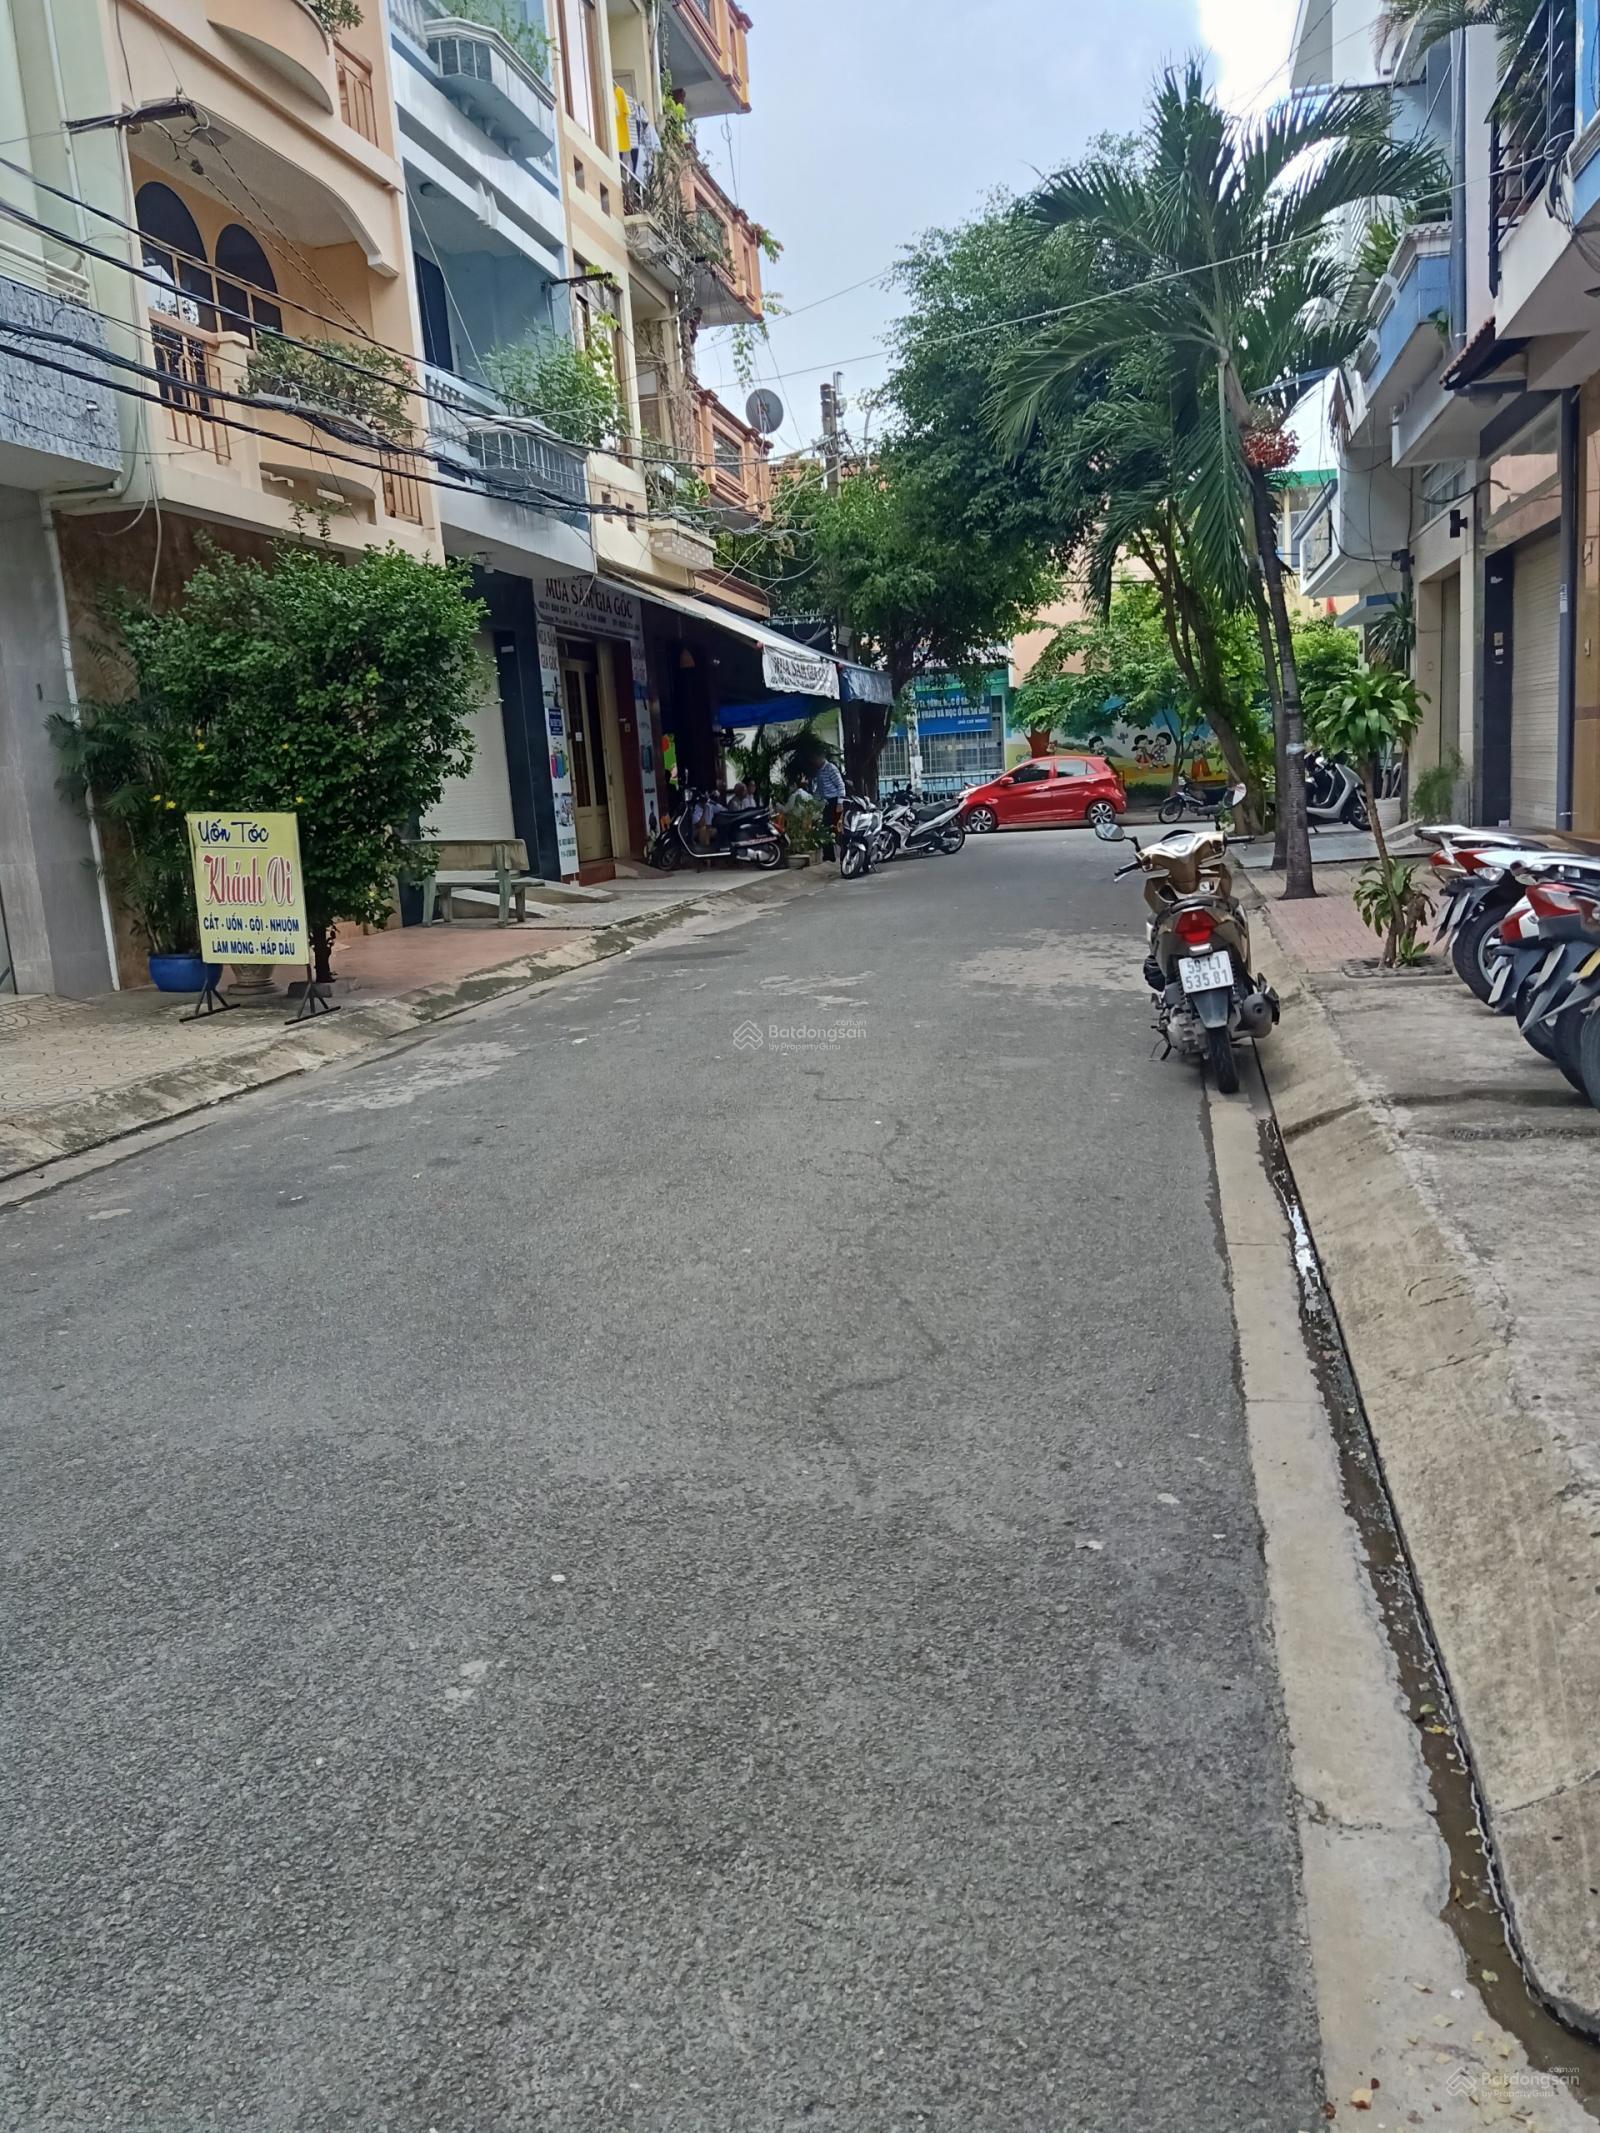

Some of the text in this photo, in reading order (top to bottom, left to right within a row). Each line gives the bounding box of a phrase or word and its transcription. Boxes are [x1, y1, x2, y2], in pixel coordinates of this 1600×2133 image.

[545, 578, 569, 602] MUA
[198, 819, 270, 844] Uốn Tóc
[203, 855, 295, 906] Khánh Vi
[226, 912, 243, 931] UỐN
